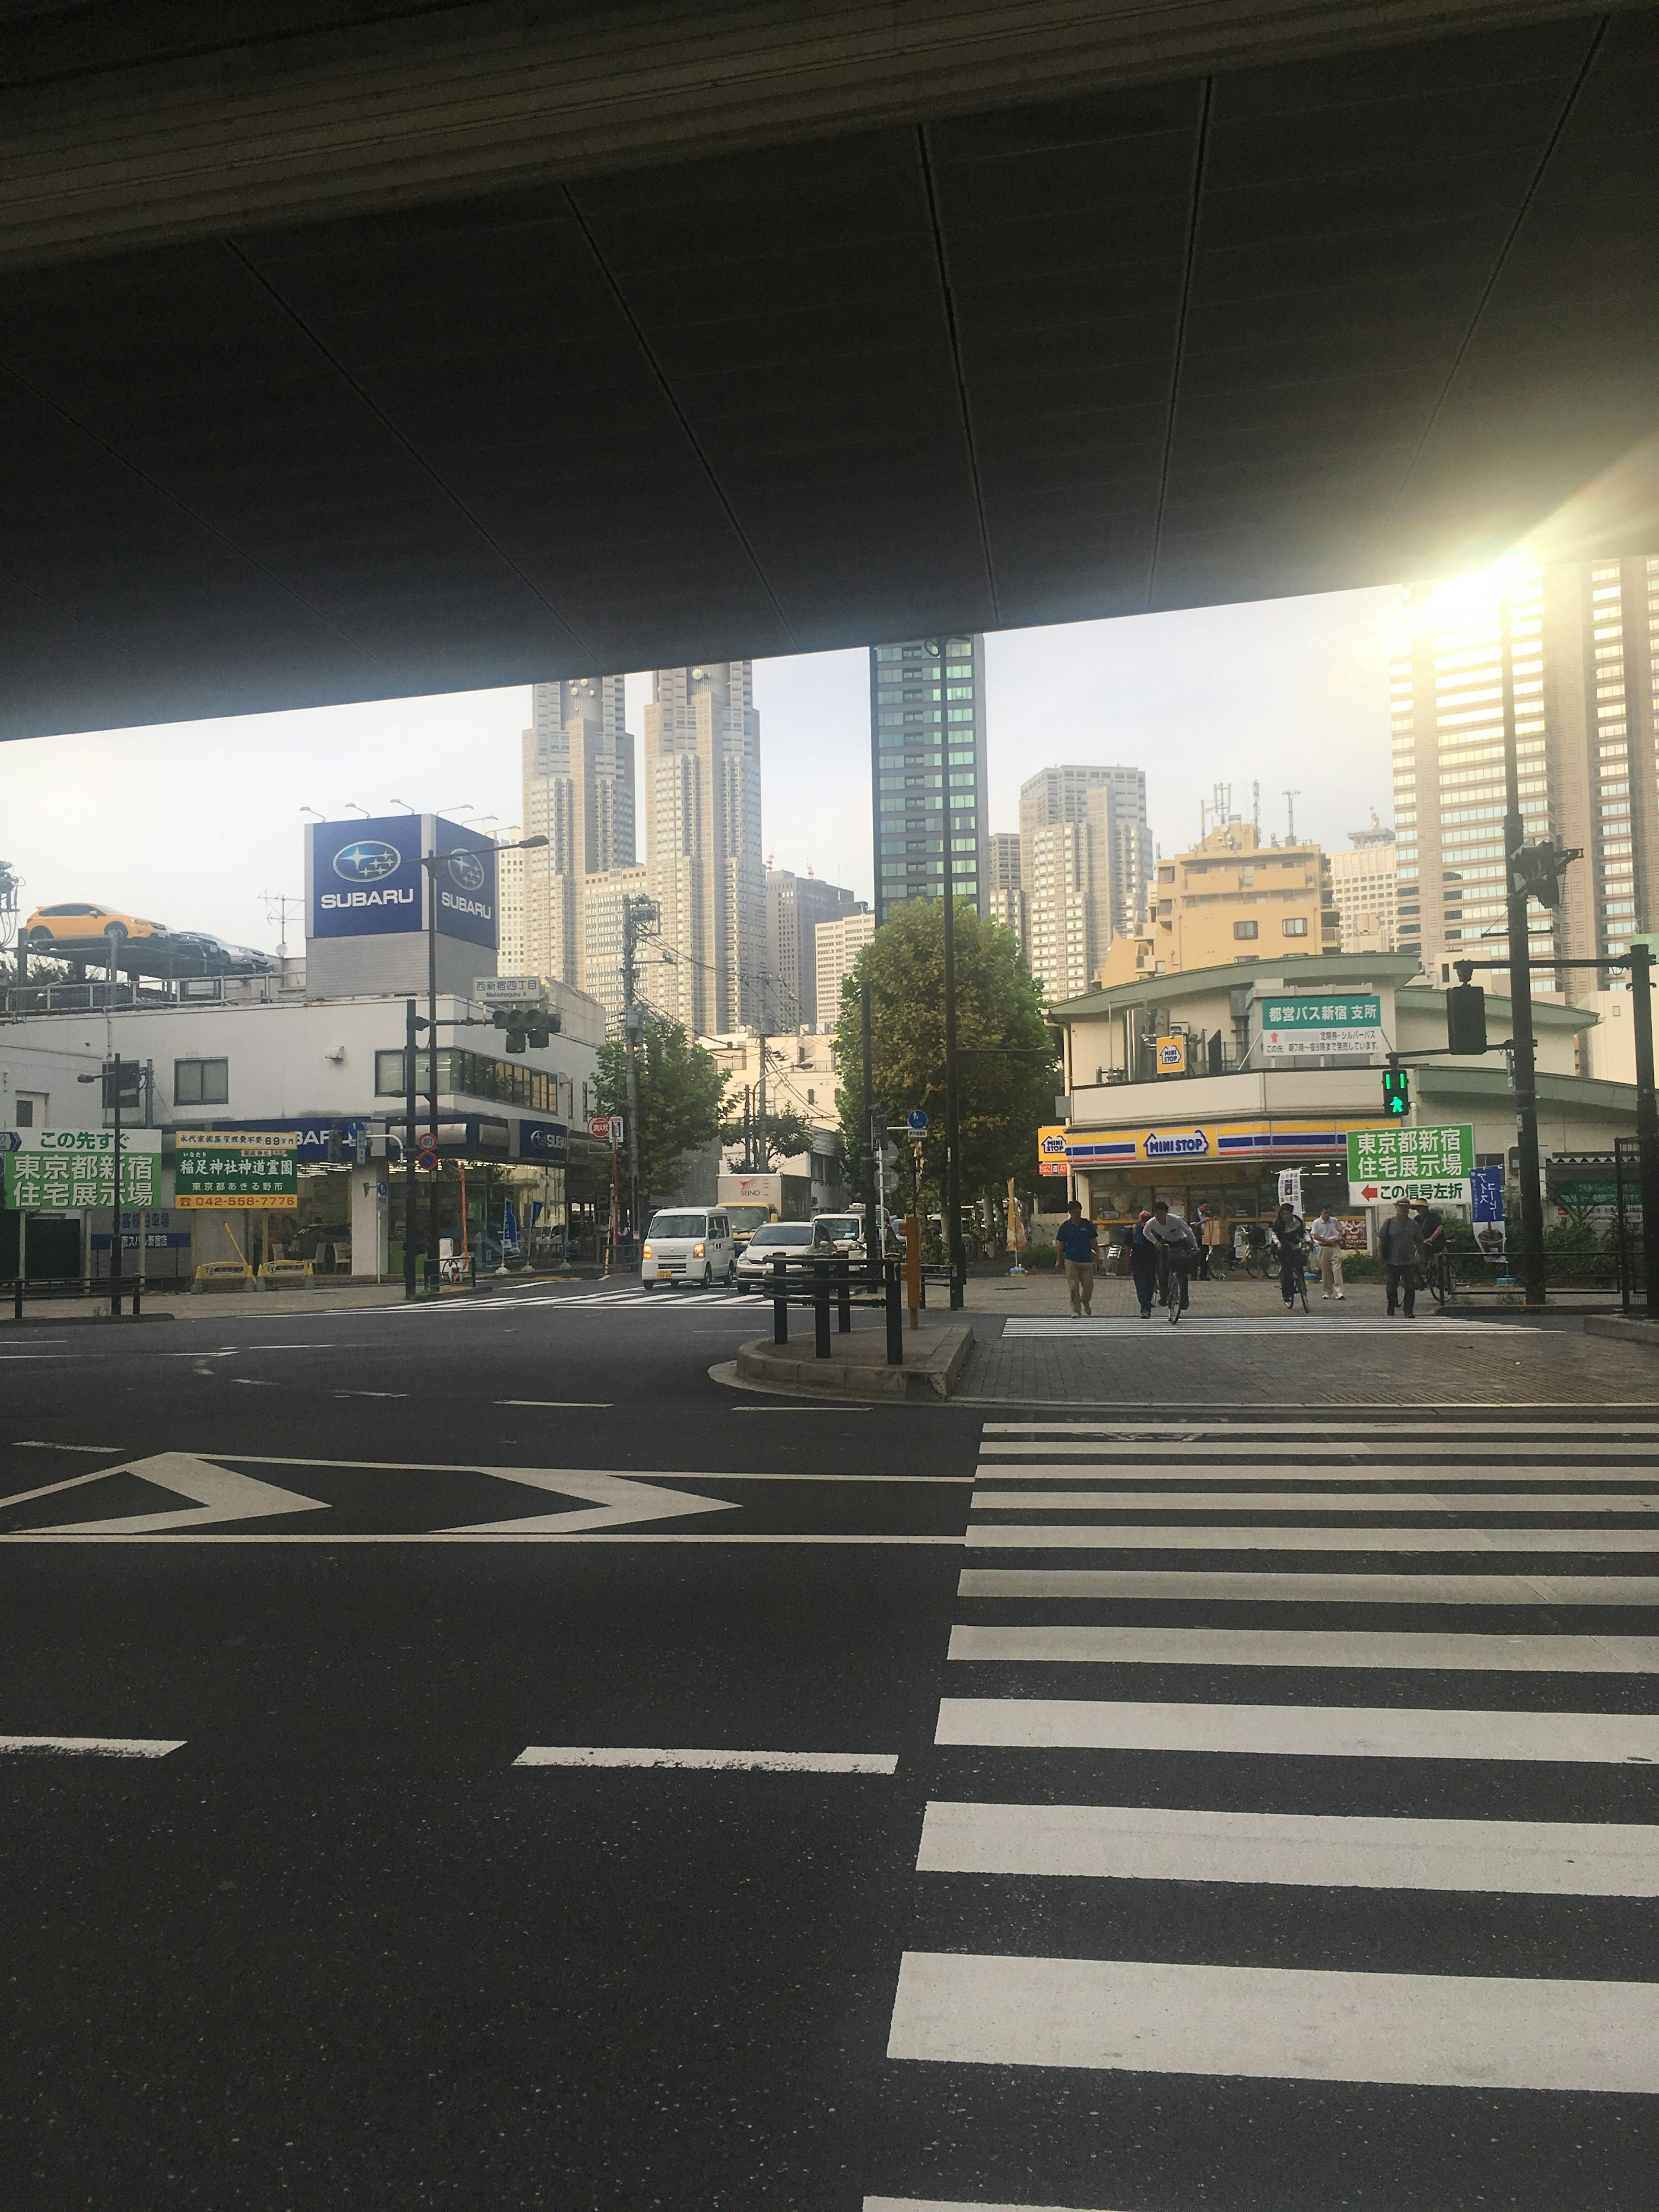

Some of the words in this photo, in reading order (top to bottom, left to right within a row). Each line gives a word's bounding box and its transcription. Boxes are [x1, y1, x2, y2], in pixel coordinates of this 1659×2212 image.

[321, 888, 413, 909] SUBARU
[442, 892, 491, 919] SUBARU
[477, 980, 536, 991] 西新宿四丁目
[1269, 1005, 1347, 1022] 都営バス新宿
[1351, 1004, 1376, 1019] 支所
[41, 1132, 130, 1150] この先すぐ
[423, 1138, 432, 1146] 40
[1150, 1141, 1174, 1153] MINI
[1176, 1139, 1202, 1151] STOP
[1357, 1128, 1460, 1155] 東京都新宿
[14, 1155, 153, 1180] 東京都新宿
[180, 1159, 292, 1176] 稲足神社神道霊園
[1358, 1154, 1462, 1179] 住宅展示場
[14, 1182, 153, 1207] 住宅展示場
[192, 1182, 283, 1191] 東京都あきる野市
[1381, 1183, 1462, 1200] この信号左折
[196, 1197, 294, 1206] 042-558-7776
